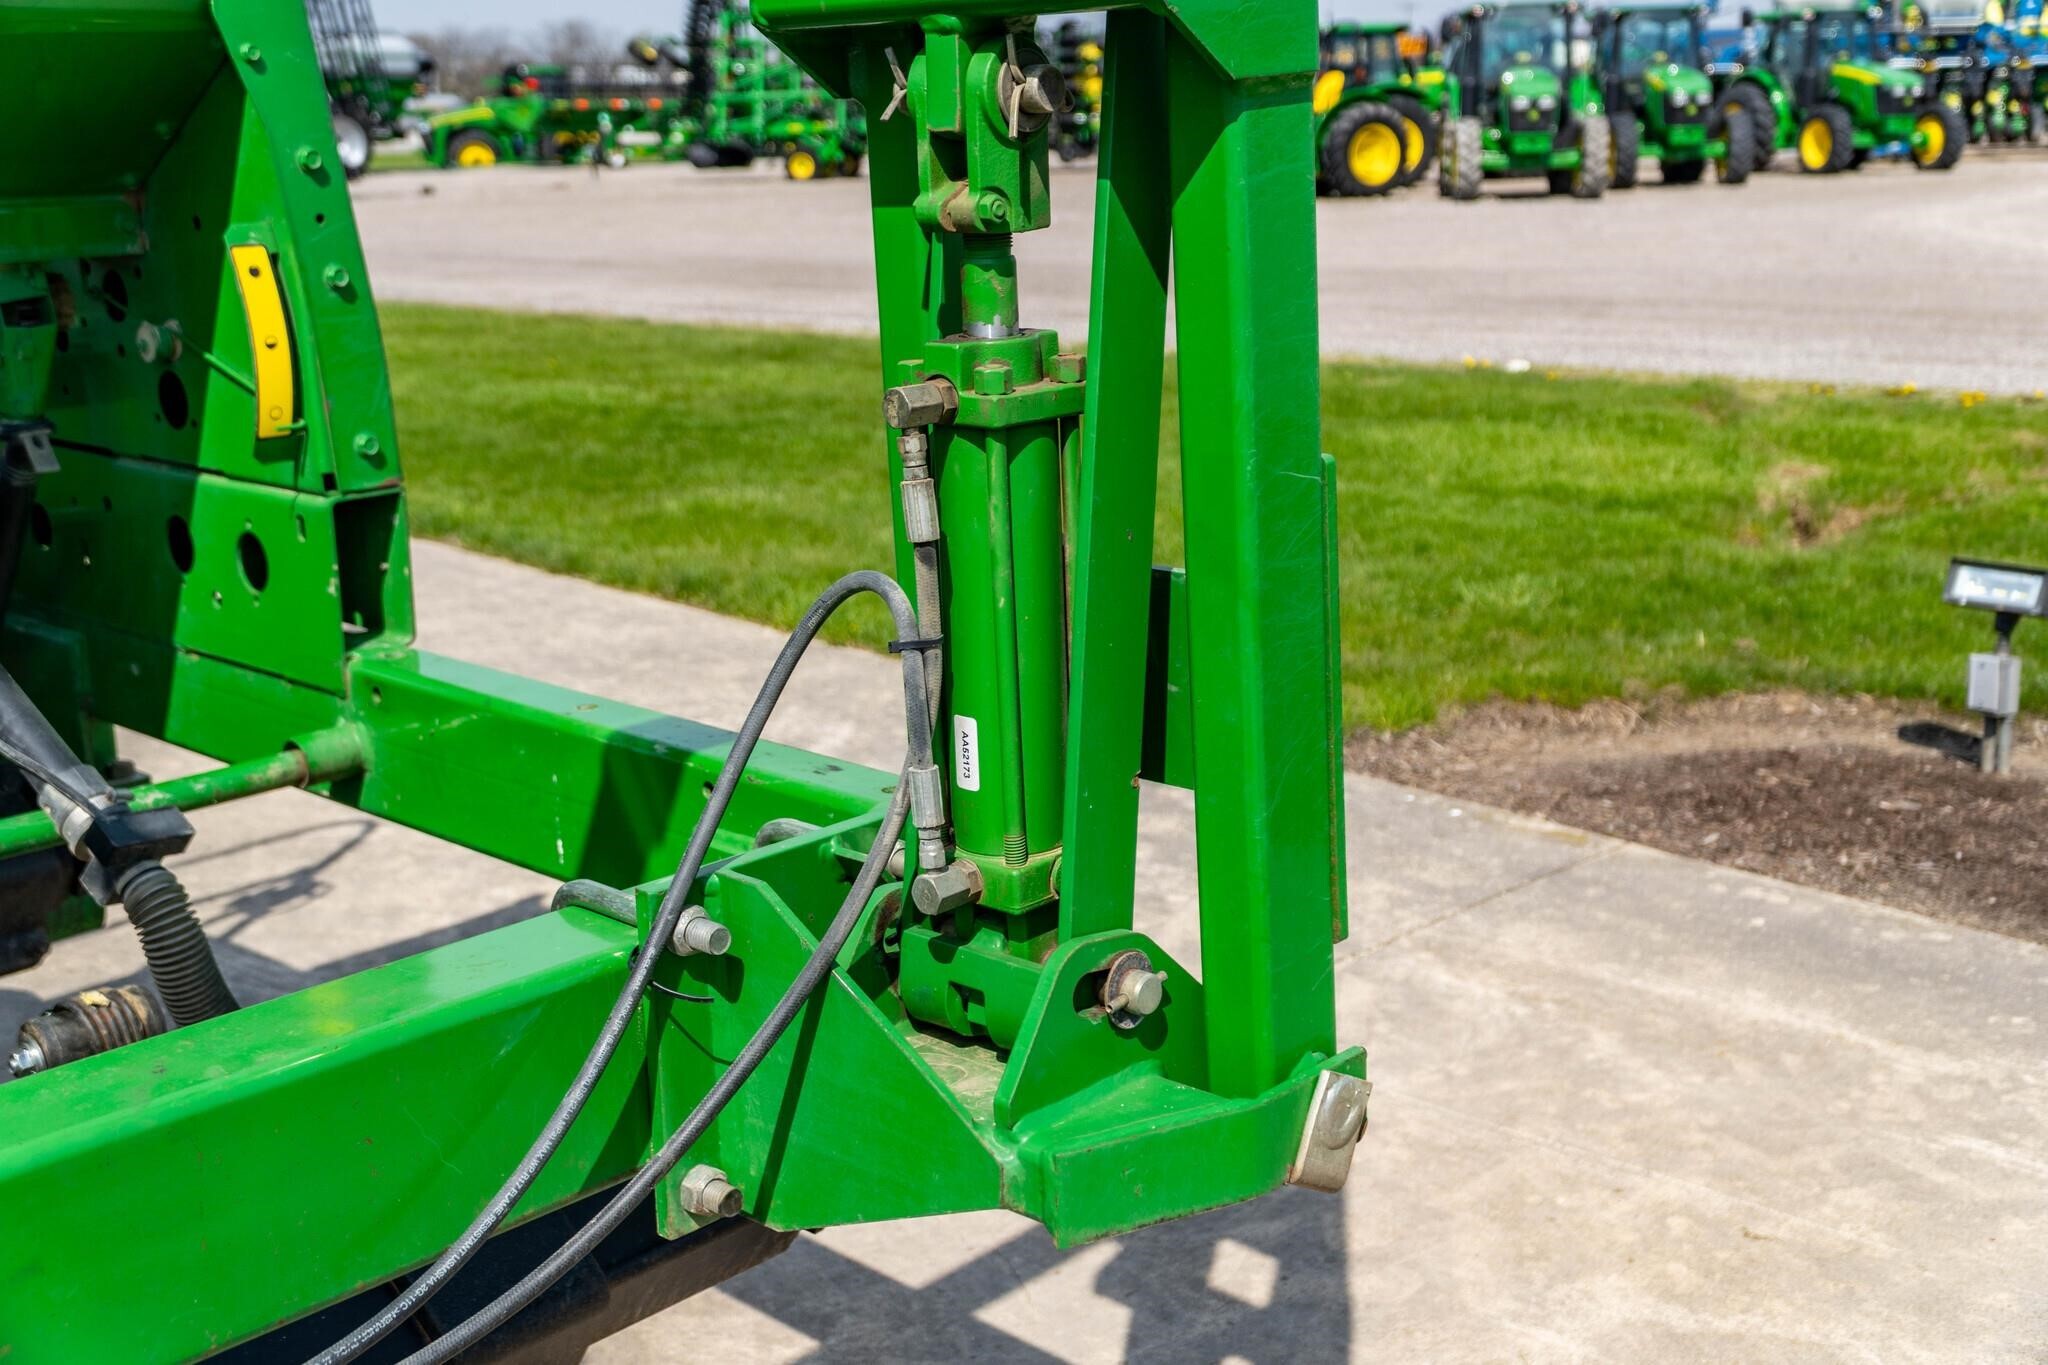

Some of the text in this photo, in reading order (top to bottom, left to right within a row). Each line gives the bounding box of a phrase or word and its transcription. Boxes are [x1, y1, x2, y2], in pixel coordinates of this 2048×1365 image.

[535, 1138, 554, 1161] MAX
[525, 1156, 541, 1175] WP
[513, 1170, 531, 1190] R17
[492, 1185, 520, 1217] FLAME
[456, 1211, 499, 1259] RESISTANT
[397, 1281, 431, 1313] 2G-11C
